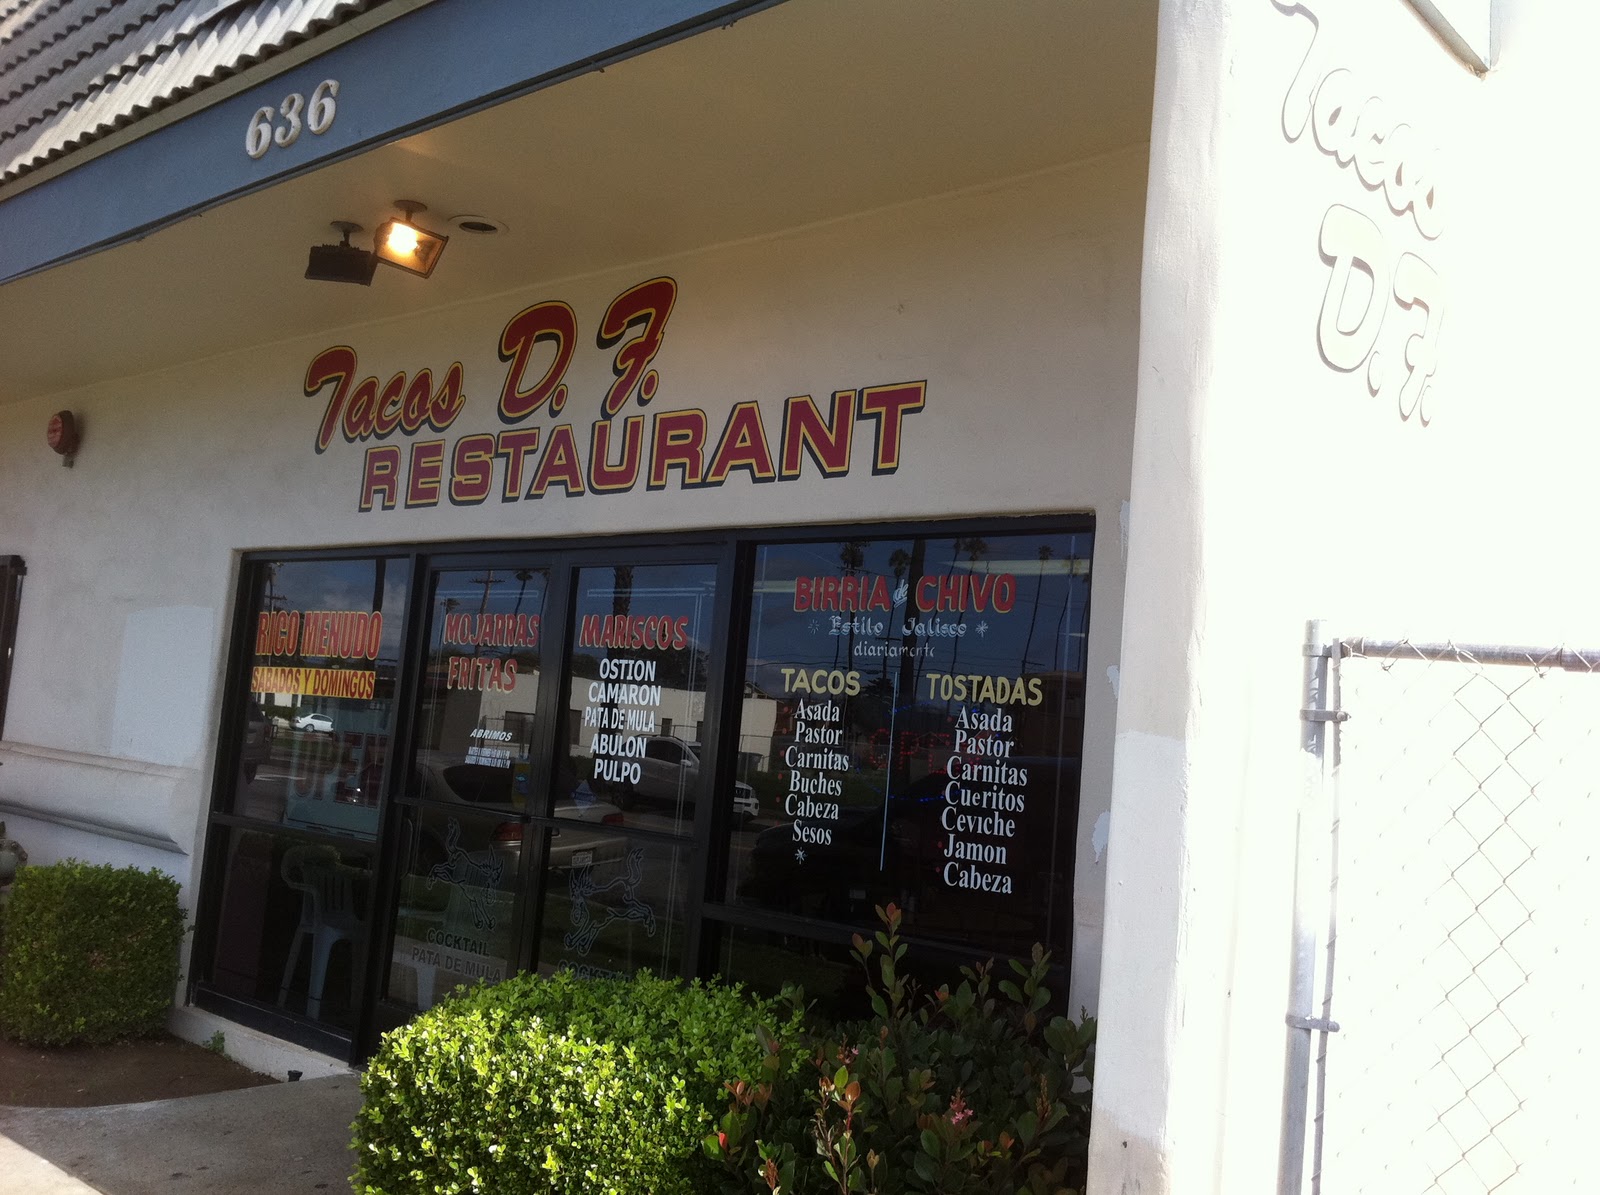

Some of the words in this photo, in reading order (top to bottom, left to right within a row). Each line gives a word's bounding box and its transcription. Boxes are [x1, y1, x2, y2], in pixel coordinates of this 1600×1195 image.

[245, 79, 340, 159] 636
[304, 345, 466, 453] Tacos
[497, 300, 578, 425] D.
[596, 275, 677, 417] F.
[358, 379, 928, 512] RESTAURANT
[793, 575, 890, 612] BIRRIA
[893, 578, 908, 607] de
[915, 572, 1016, 613] CHIVO
[255, 610, 300, 656] RICO
[300, 611, 383, 660] MENUDO
[443, 613, 541, 647] MOJARRAS
[579, 614, 689, 650] MARISCOS
[828, 615, 884, 636] Estilo
[902, 617, 967, 637] Jalisco
[252, 667, 301, 694] SABADOS
[304, 669, 312, 694] Y
[313, 669, 374, 699] DOMINGOS
[447, 656, 518, 693] FRITAS
[600, 658, 656, 682] OSTION
[781, 668, 861, 696] TACOS
[588, 682, 661, 706] CAMARON
[926, 673, 1043, 706] TOSTADAS
[584, 706, 609, 729] PATA
[611, 708, 625, 730] DE
[627, 709, 655, 733] MULA
[794, 698, 840, 722] Asada
[955, 705, 1013, 733] Asada
[470, 728, 512, 741] ABRIMOS
[590, 733, 647, 759] ABULON
[794, 721, 843, 745] Pastor
[954, 729, 1015, 758] Pastor
[594, 758, 642, 785] PULPO
[785, 745, 850, 772] Carnitas
[946, 755, 1028, 787] Carnitas
[789, 770, 842, 797] Buches
[944, 781, 1025, 813] Cueritos
[785, 793, 839, 820] Cabeza
[941, 806, 1016, 837] Ceviche
[792, 819, 832, 846] Sesos
[943, 833, 1007, 865] Jamon
[943, 861, 1012, 894] Cabeza
[427, 927, 490, 958] COCKTAIL
[411, 946, 441, 968] PATA
[444, 955, 462, 973] DE
[464, 960, 502, 983] MULA
